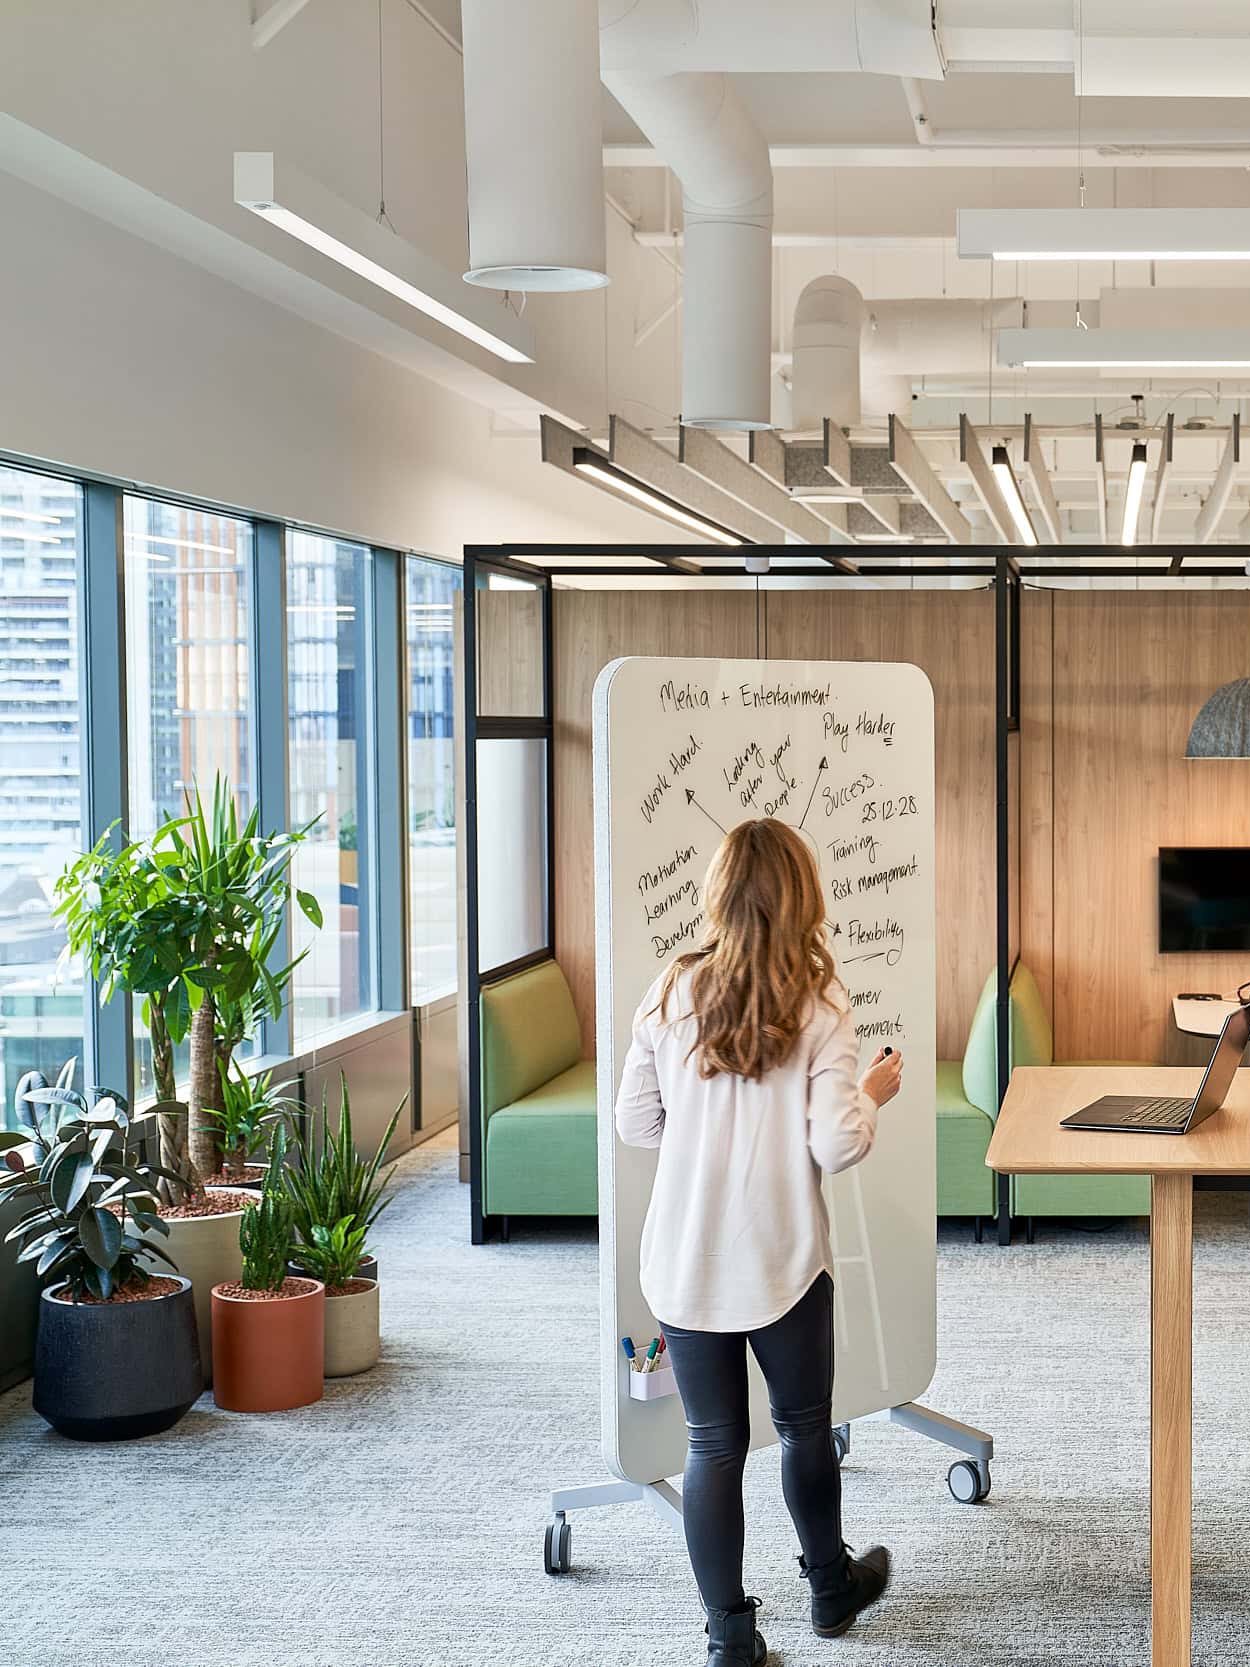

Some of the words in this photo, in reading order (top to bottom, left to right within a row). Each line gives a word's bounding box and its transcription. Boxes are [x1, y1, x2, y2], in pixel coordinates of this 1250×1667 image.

[660, 680, 711, 712] Media
[721, 691, 730, 704] +
[823, 711, 849, 752] Play
[855, 711, 895, 736] Harder
[723, 742, 765, 792] Looking
[740, 774, 762, 809] after
[769, 733, 791, 782] your
[640, 773, 672, 824] Work
[638, 845, 698, 897] Motivation
[831, 877, 853, 901] Risk
[644, 879, 701, 926] Learning
[848, 918, 904, 967] Flexibility
